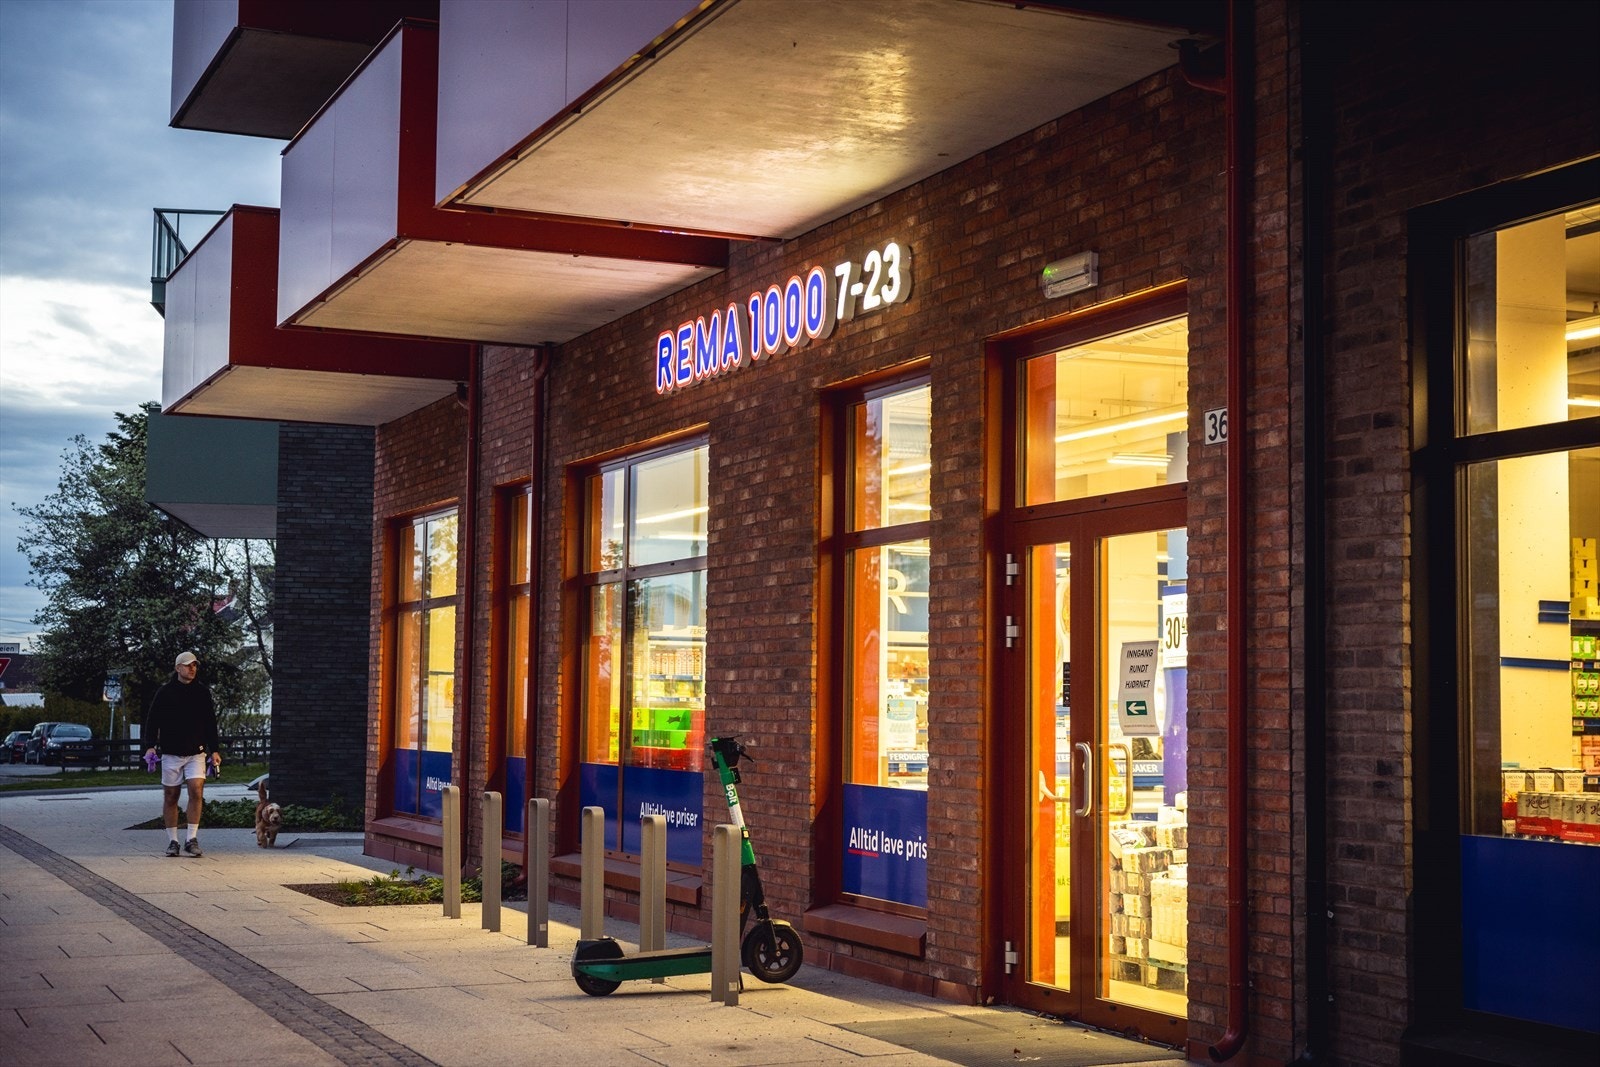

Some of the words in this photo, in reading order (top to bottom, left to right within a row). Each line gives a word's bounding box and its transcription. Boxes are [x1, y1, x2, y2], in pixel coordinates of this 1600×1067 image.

[656, 302, 742, 394] REMA
[749, 265, 827, 360] 1000
[834, 242, 901, 317] 7-23
[1208, 411, 1228, 441] 36
[1127, 649, 1153, 659] INNGANG
[1129, 665, 1148, 673] RUNDT
[1125, 680, 1150, 689] HJØRNET
[889, 752, 928, 761] FERDIGRE
[726, 783, 737, 804] Bolt
[640, 802, 659, 818] Alltid
[676, 807, 698, 828] priser
[849, 827, 879, 852] Alltid
[881, 831, 903, 856] lave
[906, 836, 928, 861] pris
